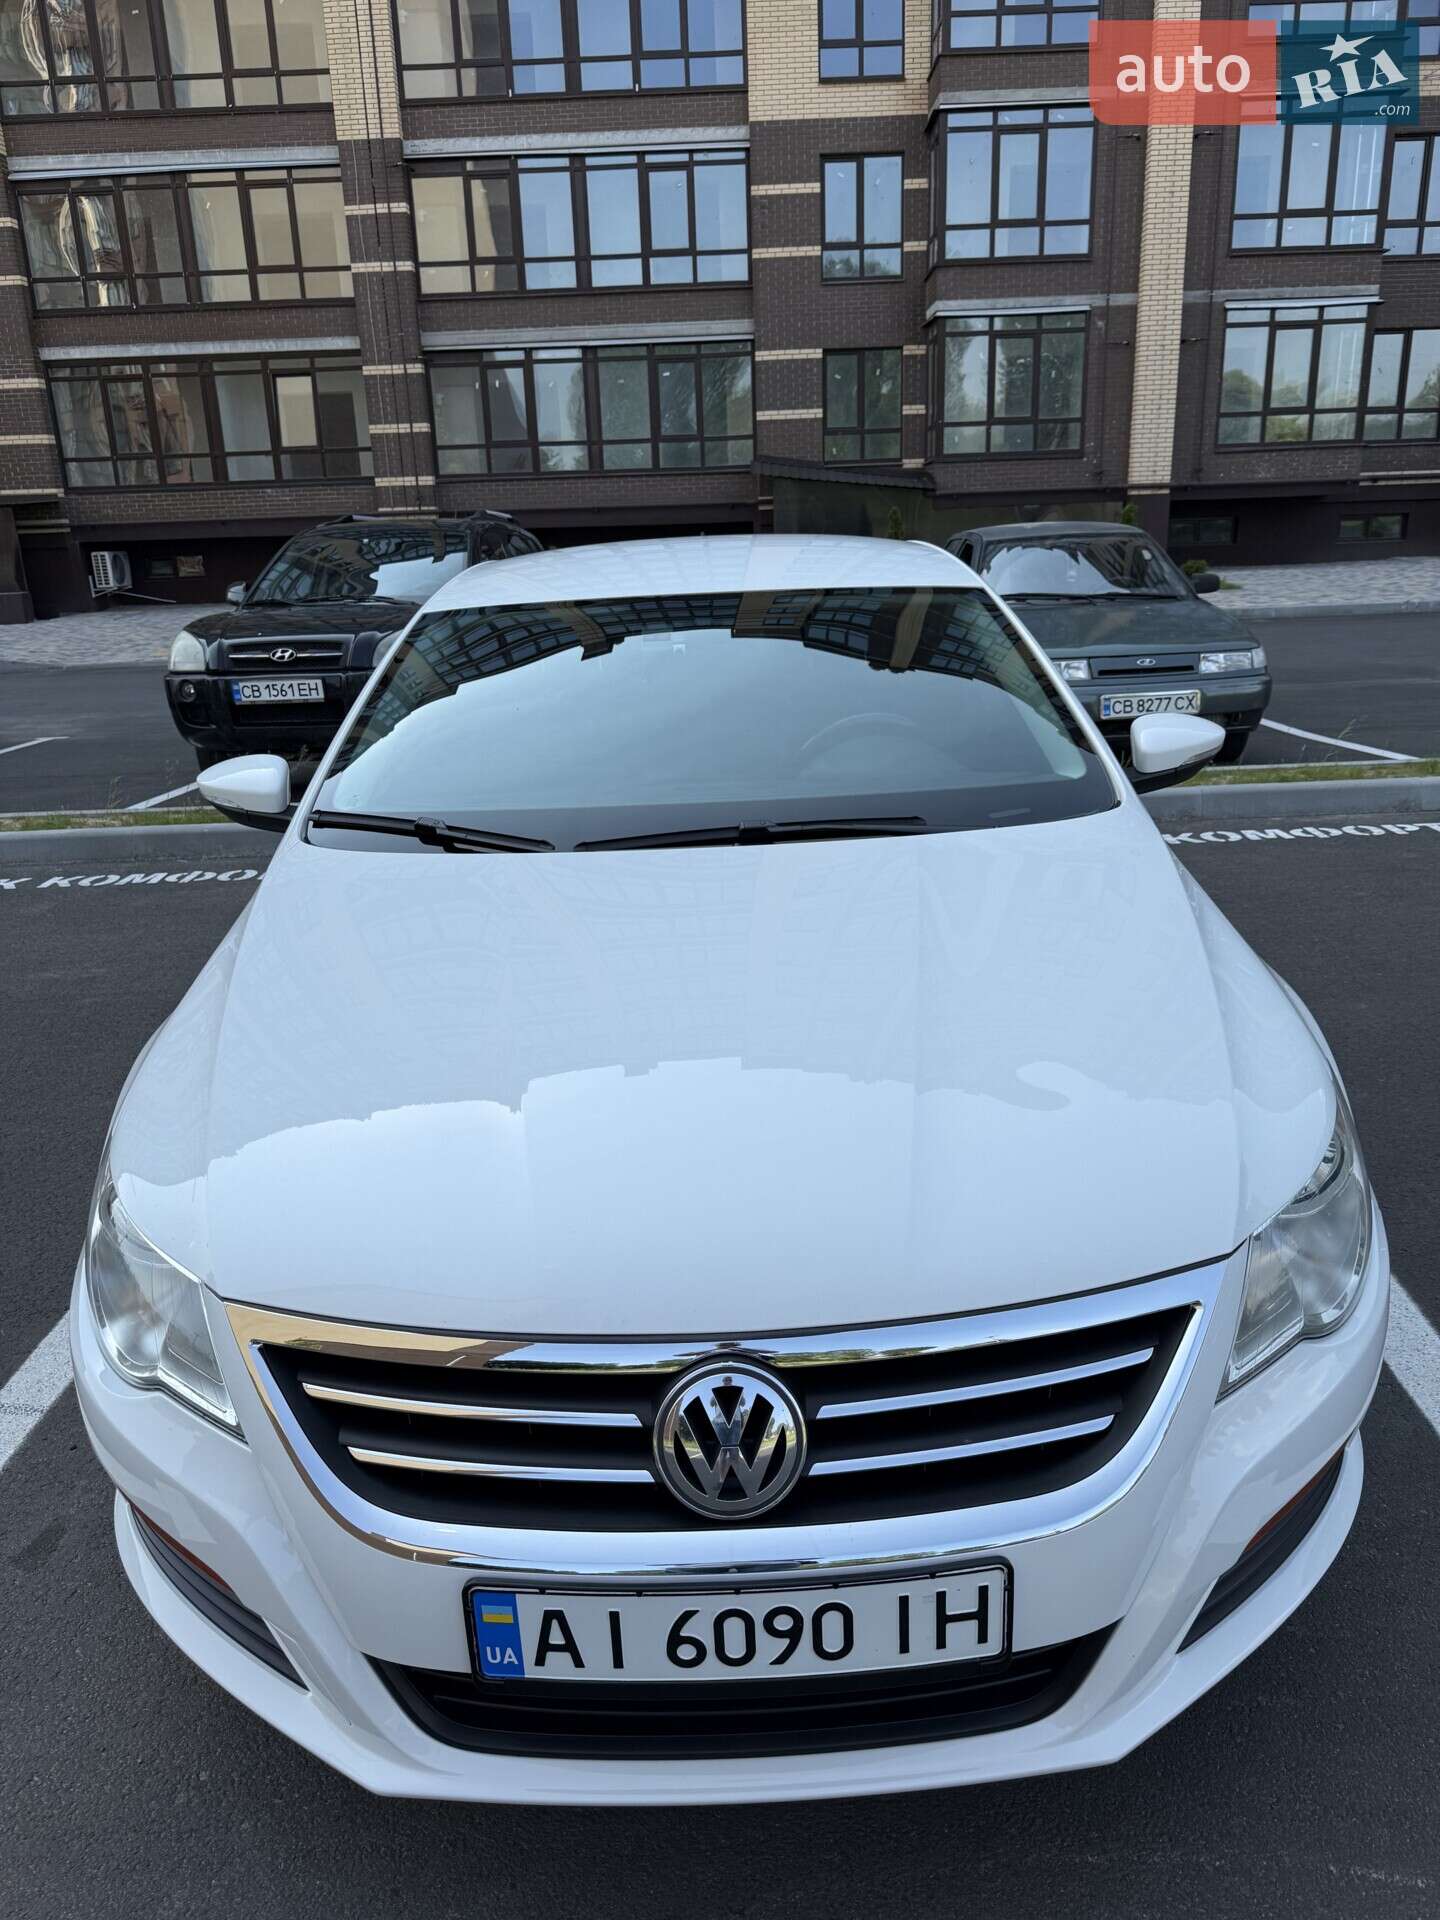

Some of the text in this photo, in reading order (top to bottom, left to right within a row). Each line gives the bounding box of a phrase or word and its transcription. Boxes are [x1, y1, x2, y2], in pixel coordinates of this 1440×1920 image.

[241, 682, 320, 699] CB 1561 EH
[1112, 700, 1134, 714] CB
[1136, 697, 1172, 713] 8277
[1174, 695, 1196, 711] CX
[533, 1584, 990, 1670] AI 6090 IH
[486, 1646, 519, 1664] UA
